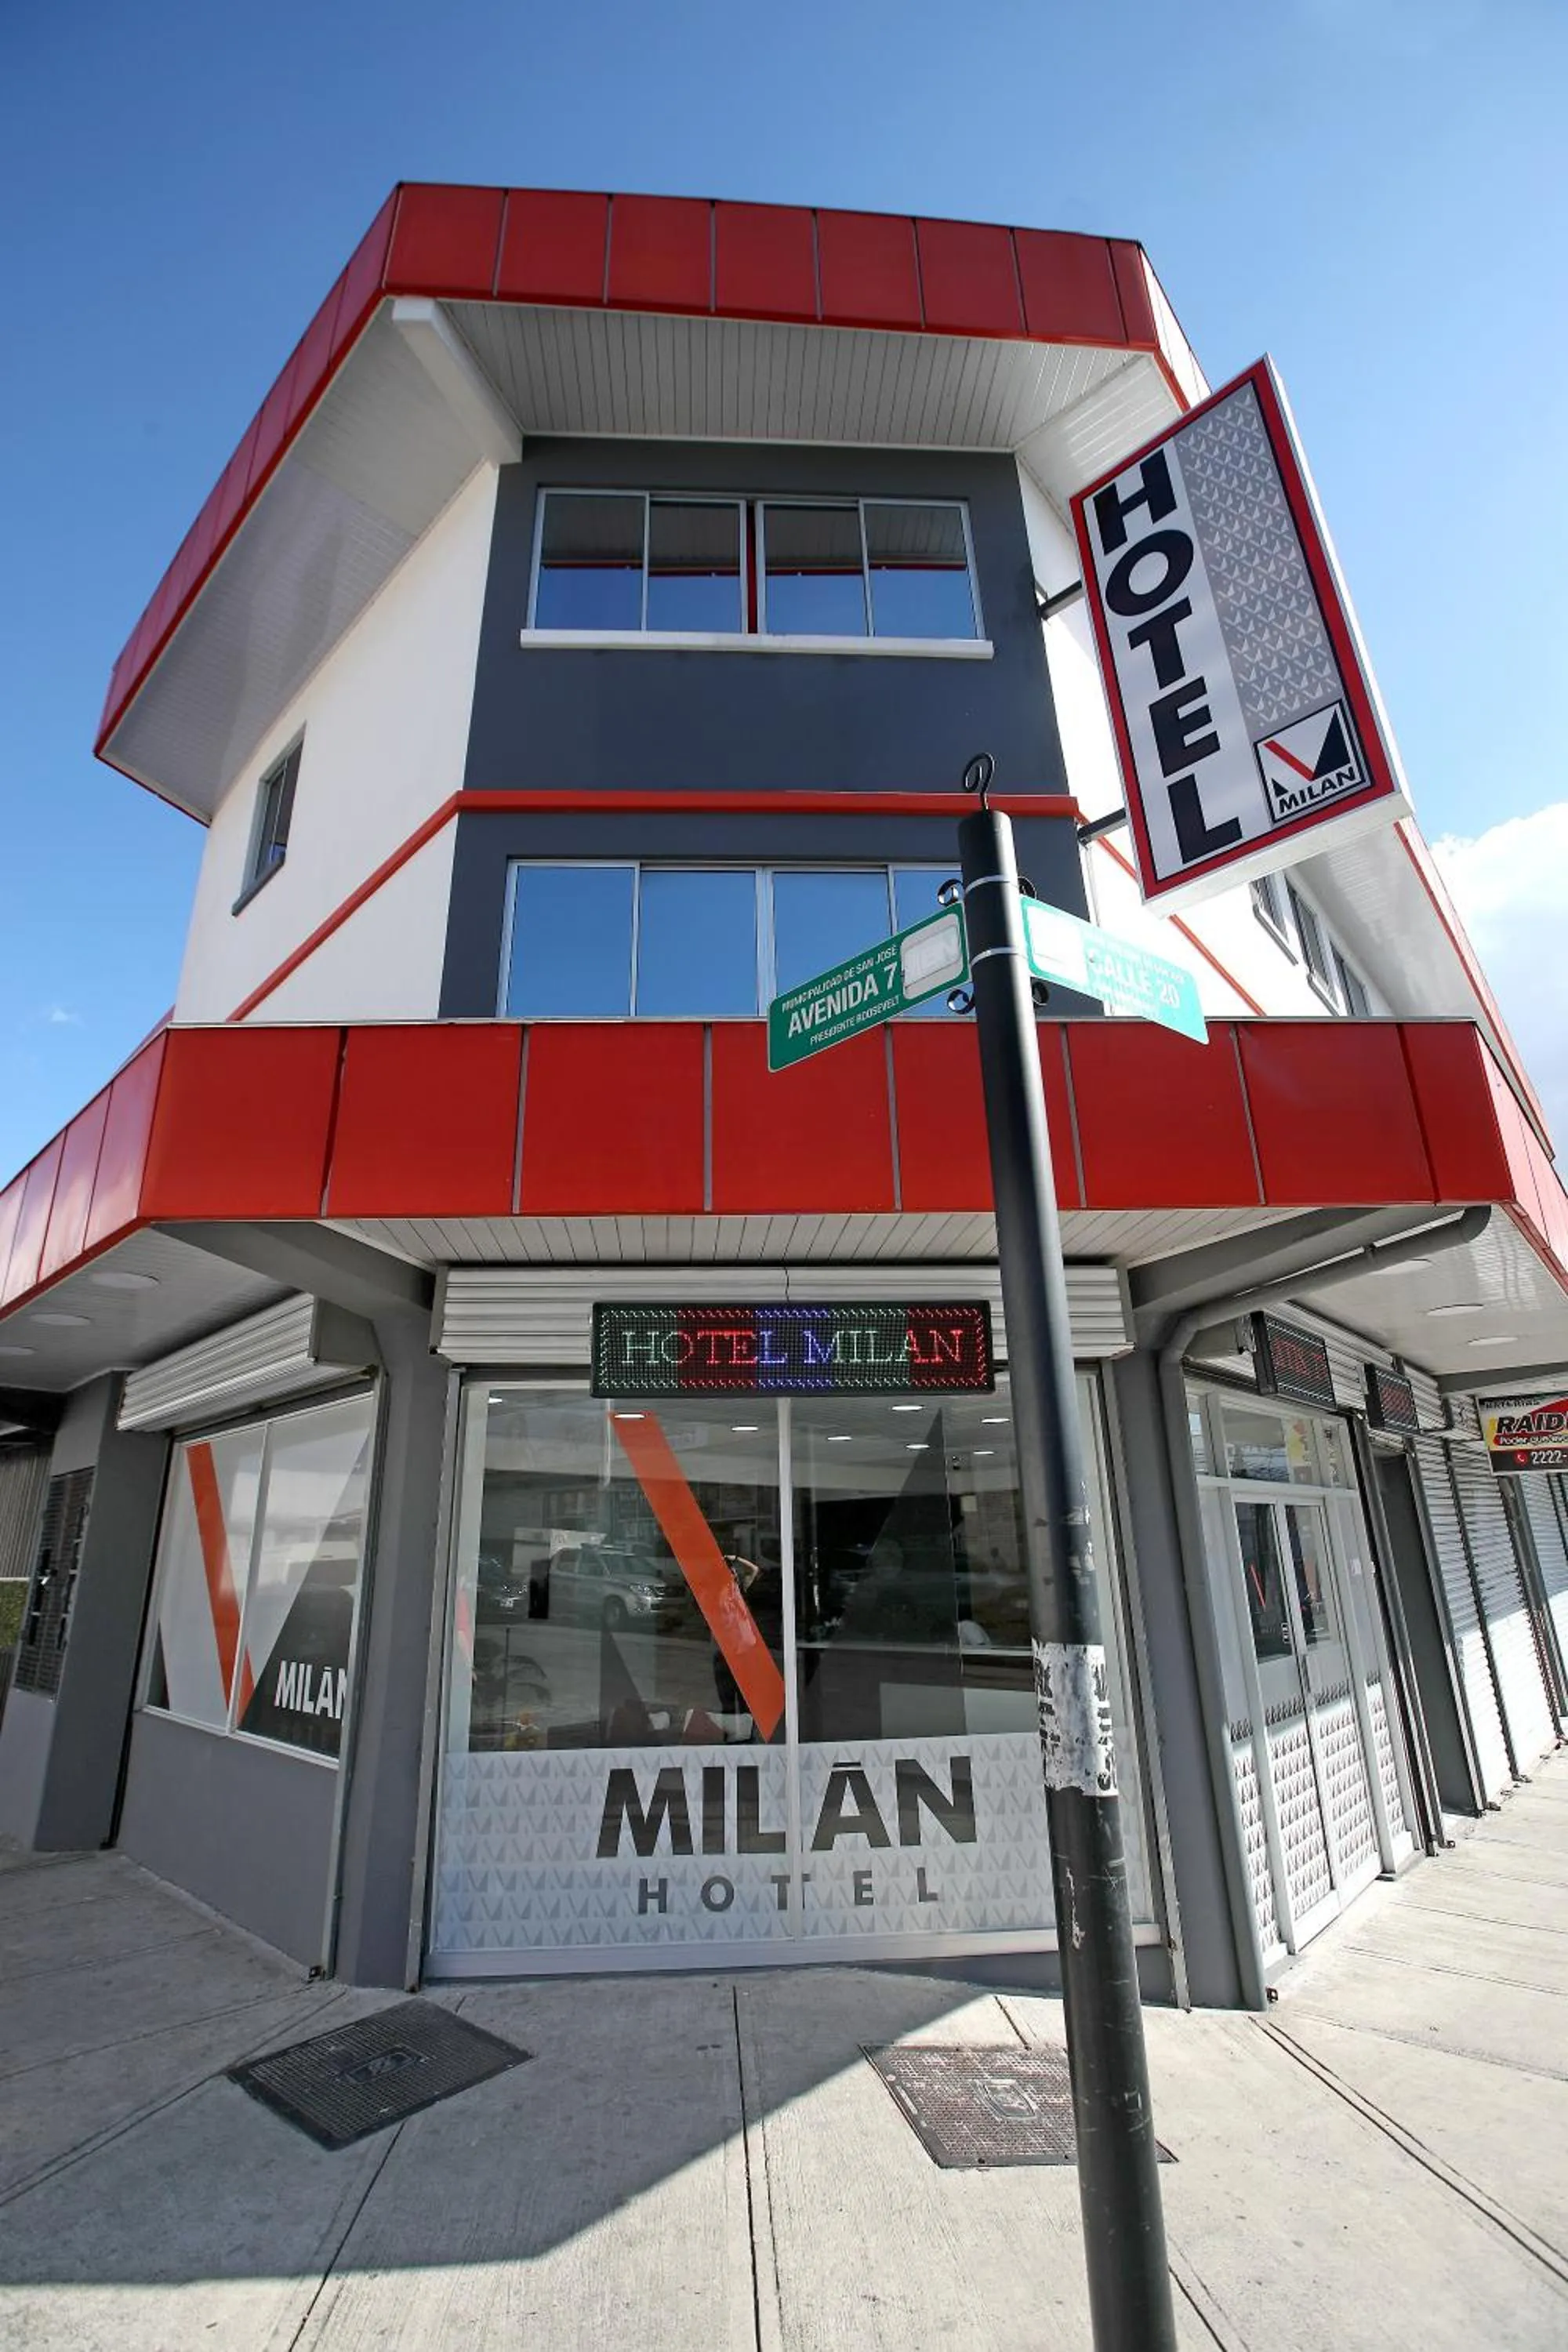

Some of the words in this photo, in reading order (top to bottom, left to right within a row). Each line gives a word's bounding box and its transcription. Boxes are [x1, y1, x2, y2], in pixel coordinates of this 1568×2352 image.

[1093, 448, 1243, 864] HOTEL
[1279, 767, 1356, 813] MILAN
[844, 967, 855, 980] DE
[856, 958, 873, 975] SAN
[788, 974, 878, 1039] AVENIDA
[884, 961, 898, 989] 7
[810, 1016, 855, 1046] PRESIDENTE
[856, 996, 900, 1024] ROOSEVELT
[622, 1330, 788, 1364] HOTEL
[804, 1330, 964, 1363] MILAN
[1497, 1412, 1568, 1434] RAID
[638, 1867, 938, 1915] HOTEL
